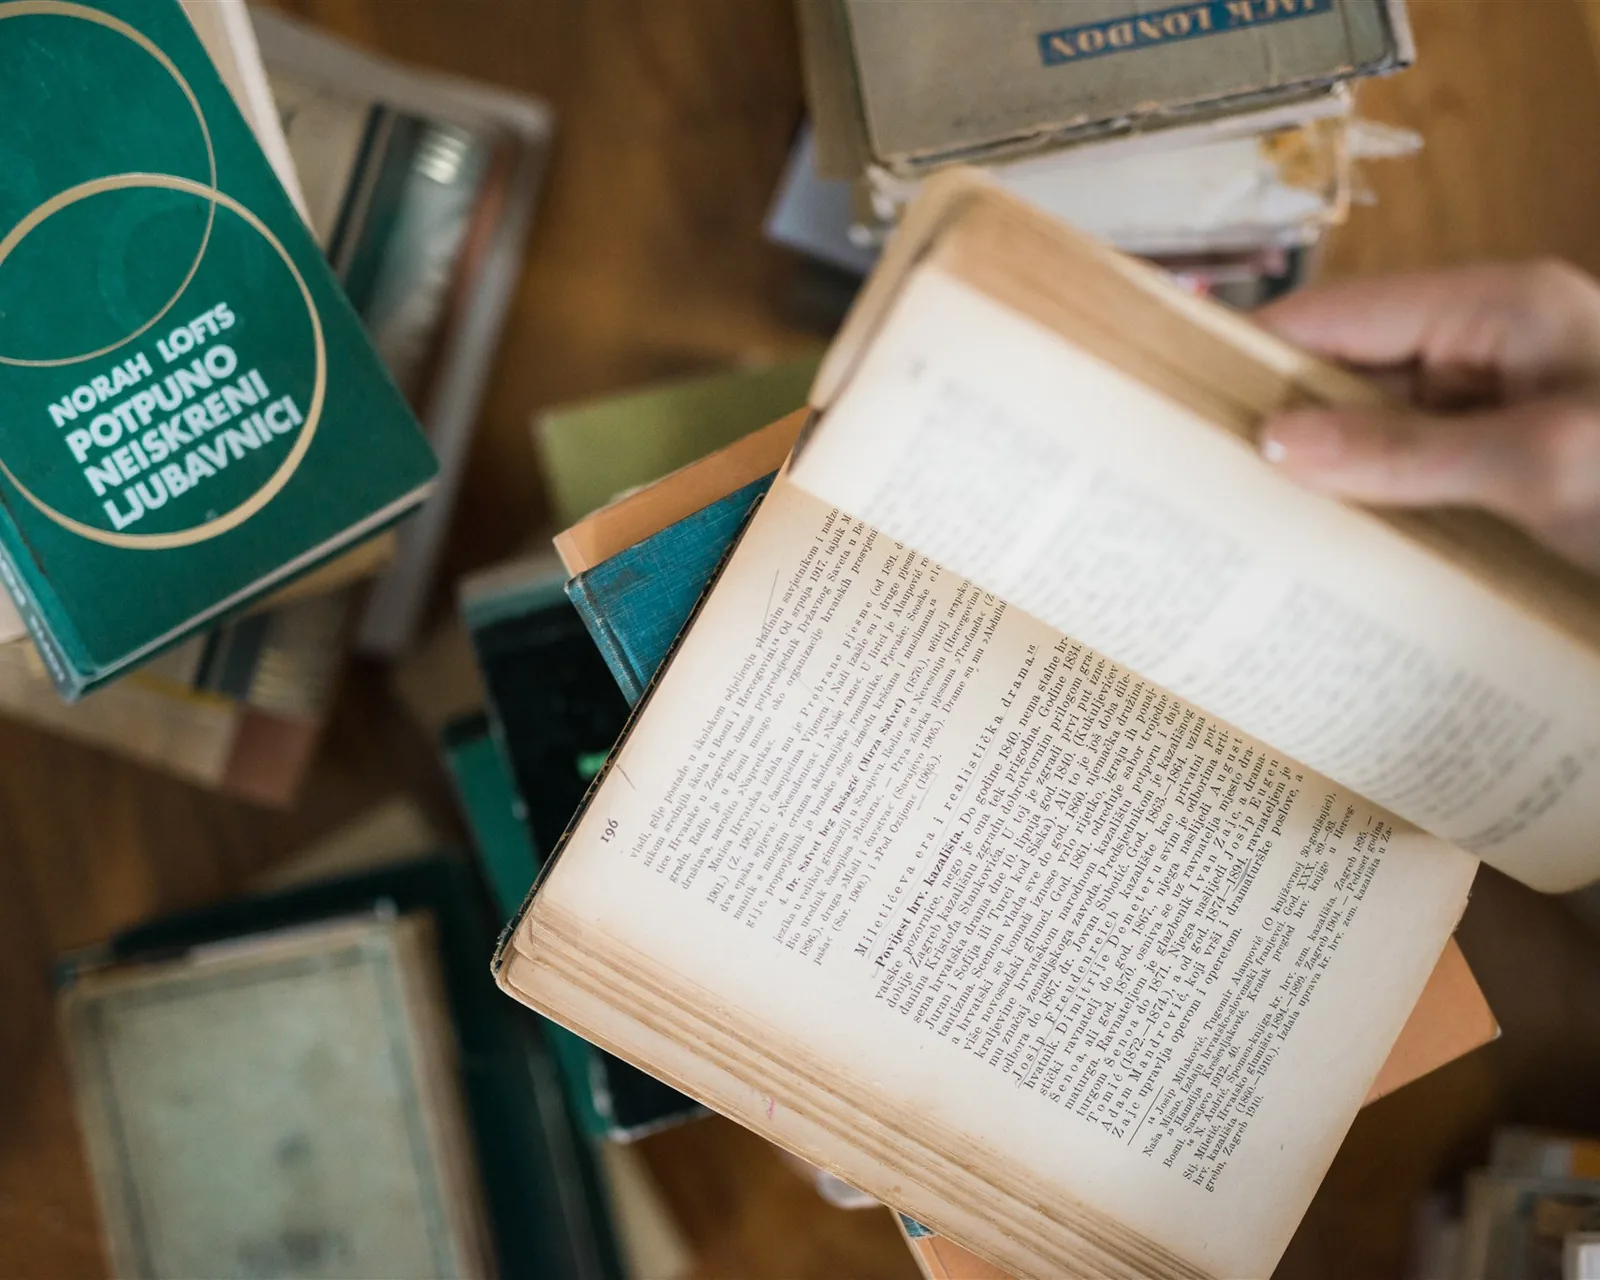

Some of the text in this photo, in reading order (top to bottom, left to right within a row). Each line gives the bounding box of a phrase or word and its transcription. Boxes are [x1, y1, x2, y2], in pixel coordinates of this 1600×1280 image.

[1049, 7, 1213, 57] LONDON
[48, 302, 236, 428] NORAH LOFTS
[65, 344, 238, 464] POTPUNO
[84, 368, 270, 496] NEISKRENI
[103, 395, 303, 530] LJUBAVNICI
[600, 818, 618, 842] 196
[874, 636, 1068, 968] Povijest hrv. kazališta. Do godine 1840. nema stalne hr-
[874, 644, 1082, 999] vatske pozornice, nego je ona tek prigodna. Godine 1834.
[885, 651, 1093, 1008] dobije Zagreb kazališnu zgradu dobrotvornim prilogom gra-
[912, 995, 934, 1024] sena
[927, 938, 968, 992] hrvatska
[963, 897, 992, 935] drama
[987, 871, 1006, 894] dne
[1001, 853, 1018, 869] 10.
[1012, 813, 1041, 849] lipnja
[1038, 785, 1058, 812] god.
[1053, 752, 1076, 780] 1840.
[923, 993, 952, 1030] Juran
[952, 944, 981, 981] Sofija
[976, 924, 992, 940] ili
[986, 885, 1015, 920] Turci
[1009, 858, 1031, 883] kod
[1025, 815, 1058, 857] Siska).
[1053, 787, 1071, 810] Ali
[1067, 772, 1080, 786] to
[1076, 755, 1090, 771] je
[1084, 732, 1102, 754] još
[1097, 702, 1118, 730] doba
[1113, 673, 1130, 698] dile-
[936, 681, 1146, 1037] tantizma. Scenom vlada sve do god. 1860. njemačka družina,
[972, 996, 1017, 1059] kraljevine
[1012, 926, 1059, 991] hrvatskom
[1057, 861, 1097, 921] narodnom
[1092, 798, 1132, 855] kazalištu
[1131, 744, 1161, 794] potporu
[1163, 701, 1181, 725] daje
[988, 708, 1195, 1067] mu značaj zemaljskoga zavoda. Predsjednikom je kazališnog
[1001, 1032, 1030, 1073] odbora
[1026, 1012, 1041, 1028] do
[1038, 978, 1062, 1007] 1867.
[1058, 958, 1074, 974] dr.
[1071, 915, 1099, 952] Jovan
[1094, 863, 1130, 911] Subotić.
[1125, 831, 1149, 858] God.
[1184, 716, 1206, 750] uzima
[1013, 1035, 1049, 1085] Josip
[1117, 843, 1157, 899] kazalište
[1153, 812, 1173, 836] kao
[1174, 753, 1204, 806] privatni
[1202, 723, 1220, 748] pot-
[1085, 1072, 1123, 1123] Tomić
[1172, 974, 1181, 983] a
[1179, 954, 1192, 971] od
[1190, 927, 1209, 954] god.
[1245, 781, 1286, 852] ravnateljem
[1278, 765, 1291, 780] je
[1110, 1101, 1140, 1139] Zajc
[1137, 1046, 1173, 1097] upravlja
[1170, 998, 1201, 1043] operom
[1204, 927, 1242, 985] operetom.
